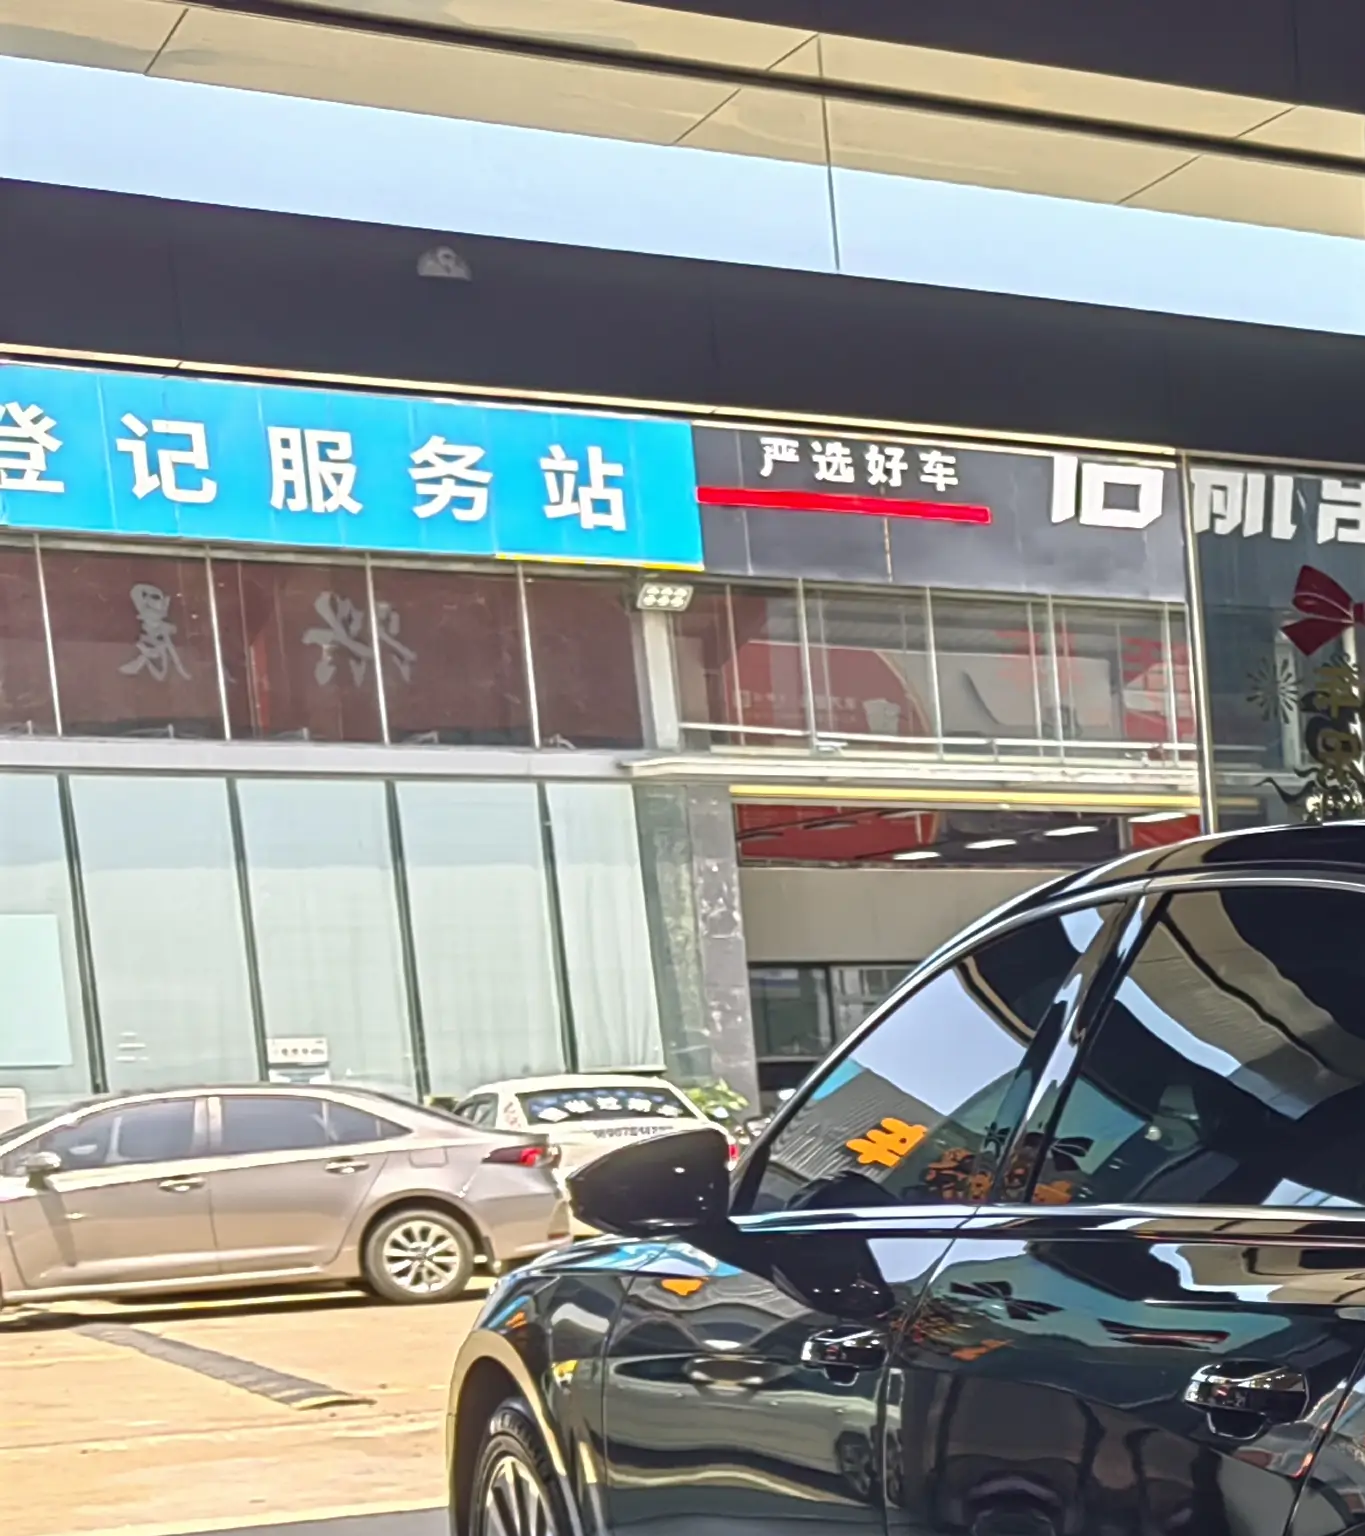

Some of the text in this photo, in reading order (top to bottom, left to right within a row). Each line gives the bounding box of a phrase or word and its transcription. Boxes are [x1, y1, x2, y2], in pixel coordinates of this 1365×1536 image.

[0, 401, 628, 532] 登记服务站
[760, 435, 959, 492] 严选好车
